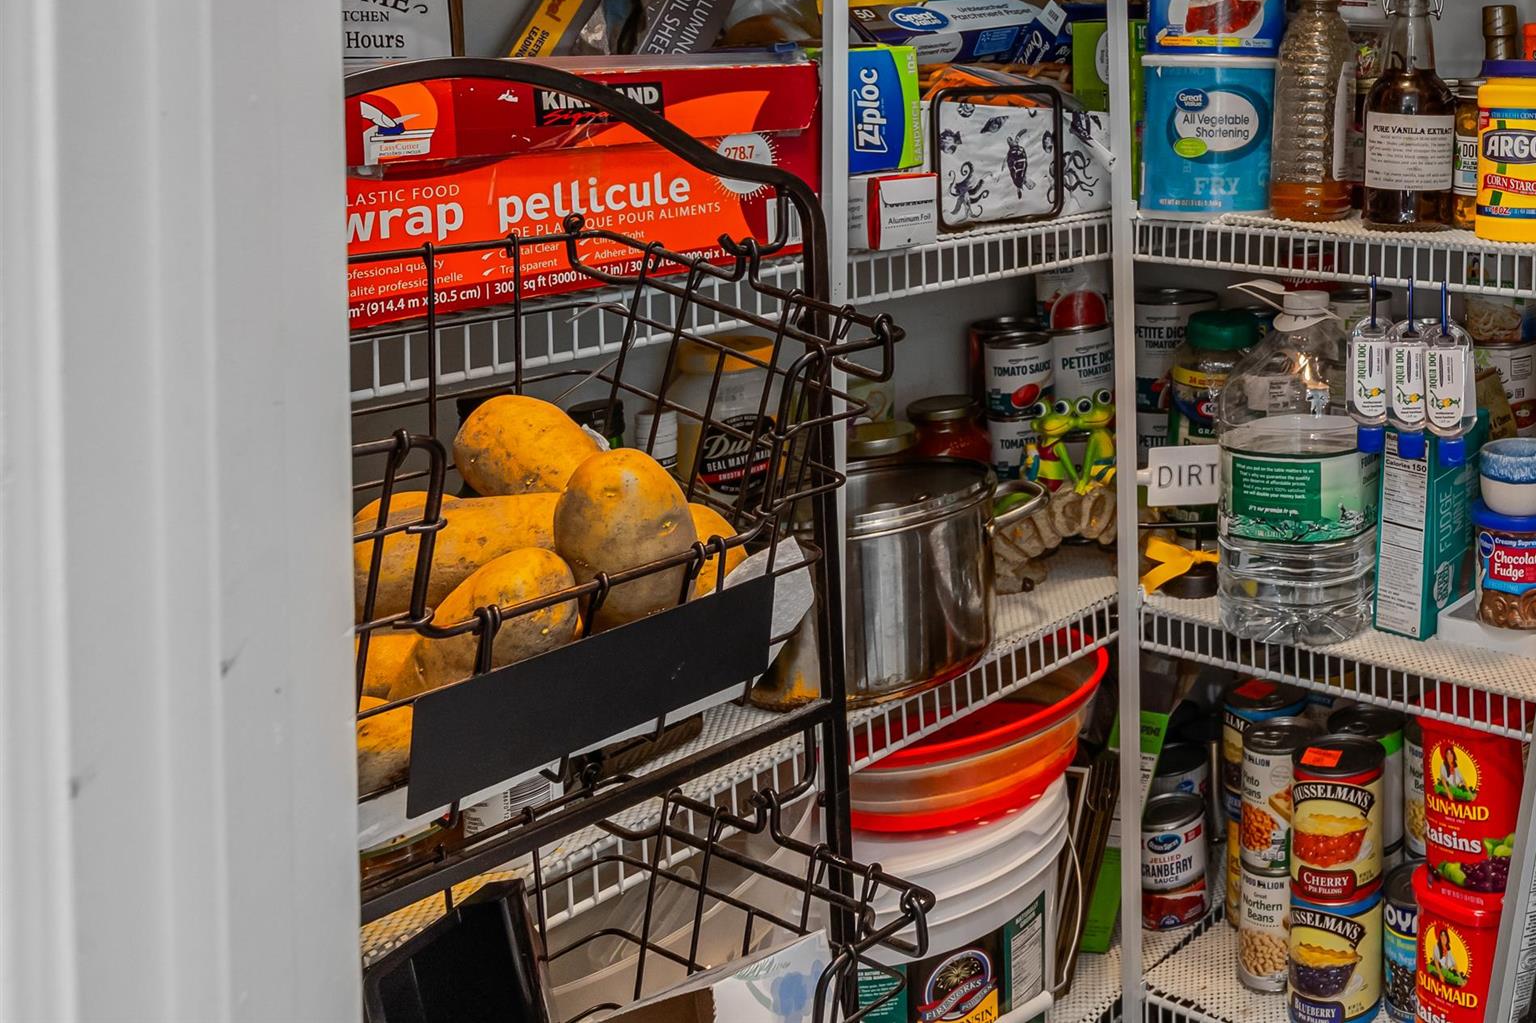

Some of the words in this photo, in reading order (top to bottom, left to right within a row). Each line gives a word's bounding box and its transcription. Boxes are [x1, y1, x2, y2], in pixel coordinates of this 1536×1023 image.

[855, 8, 876, 21] 50
[950, 8, 1005, 22] Parchment
[1005, 7, 1033, 18] Paper
[956, 2, 1010, 14] Unbleached
[895, 12, 937, 23] Great
[346, 31, 406, 50] Hours
[907, 53, 915, 75] 105
[1178, 92, 1203, 104] Great
[1184, 99, 1203, 108] Value
[857, 67, 887, 147] Ziploc
[1182, 114, 1196, 126] All
[1196, 113, 1250, 128] Vegetable
[911, 100, 924, 163] SANDWICH
[1195, 125, 1250, 141] Shortening
[1372, 125, 1390, 134] PURE
[1391, 126, 1426, 135] VANILLA
[378, 142, 420, 152] EasyCutter
[723, 145, 756, 160] 278.7
[1193, 176, 1241, 195] FRY
[1486, 174, 1508, 188] CORN
[411, 184, 460, 201] FOOD
[498, 171, 690, 232] pellicule
[618, 209, 655, 224] POUR
[658, 201, 722, 220] ALIMENTS
[888, 215, 919, 226] Aluminum
[919, 212, 932, 222] Foil
[346, 199, 464, 244] wrap
[535, 241, 560, 254] Clear
[366, 297, 406, 317] (914.4
[458, 285, 481, 302] cm)
[523, 278, 537, 291] sq
[537, 274, 547, 288] ft
[547, 272, 578, 288] (3000
[1357, 343, 1367, 359] DOC
[1395, 348, 1405, 363] DOC
[1428, 351, 1437, 366] DOC
[993, 365, 1028, 377] TOMATO
[1028, 359, 1052, 375] SAUCE
[1061, 353, 1098, 370] PETITE
[1077, 363, 1112, 378] TOMATOES
[706, 461, 727, 473] REAL
[1385, 458, 1411, 471] Calories
[1411, 463, 1427, 474] 150
[1157, 464, 1218, 489] DIRT
[1452, 489, 1466, 535] MINT
[1439, 491, 1453, 554] FUDGE
[1494, 537, 1517, 547] Creamy
[1493, 562, 1525, 582] Fudge
[1426, 793, 1490, 821] SUN-MAID
[1425, 820, 1483, 854] Raisins
[1149, 853, 1182, 865] JELLIED
[1153, 876, 1180, 885] SAUCE
[1263, 879, 1285, 890] LION
[1303, 870, 1350, 888] CHERRY
[1253, 891, 1268, 899] Great
[1318, 886, 1343, 896] FILLING
[1242, 894, 1283, 911] Northern
[1247, 907, 1275, 924] Beans
[1417, 972, 1479, 1010] SUN-MAID
[924, 977, 984, 1022] FIREWORKS
[1294, 999, 1337, 1019] BLUEBERRY
